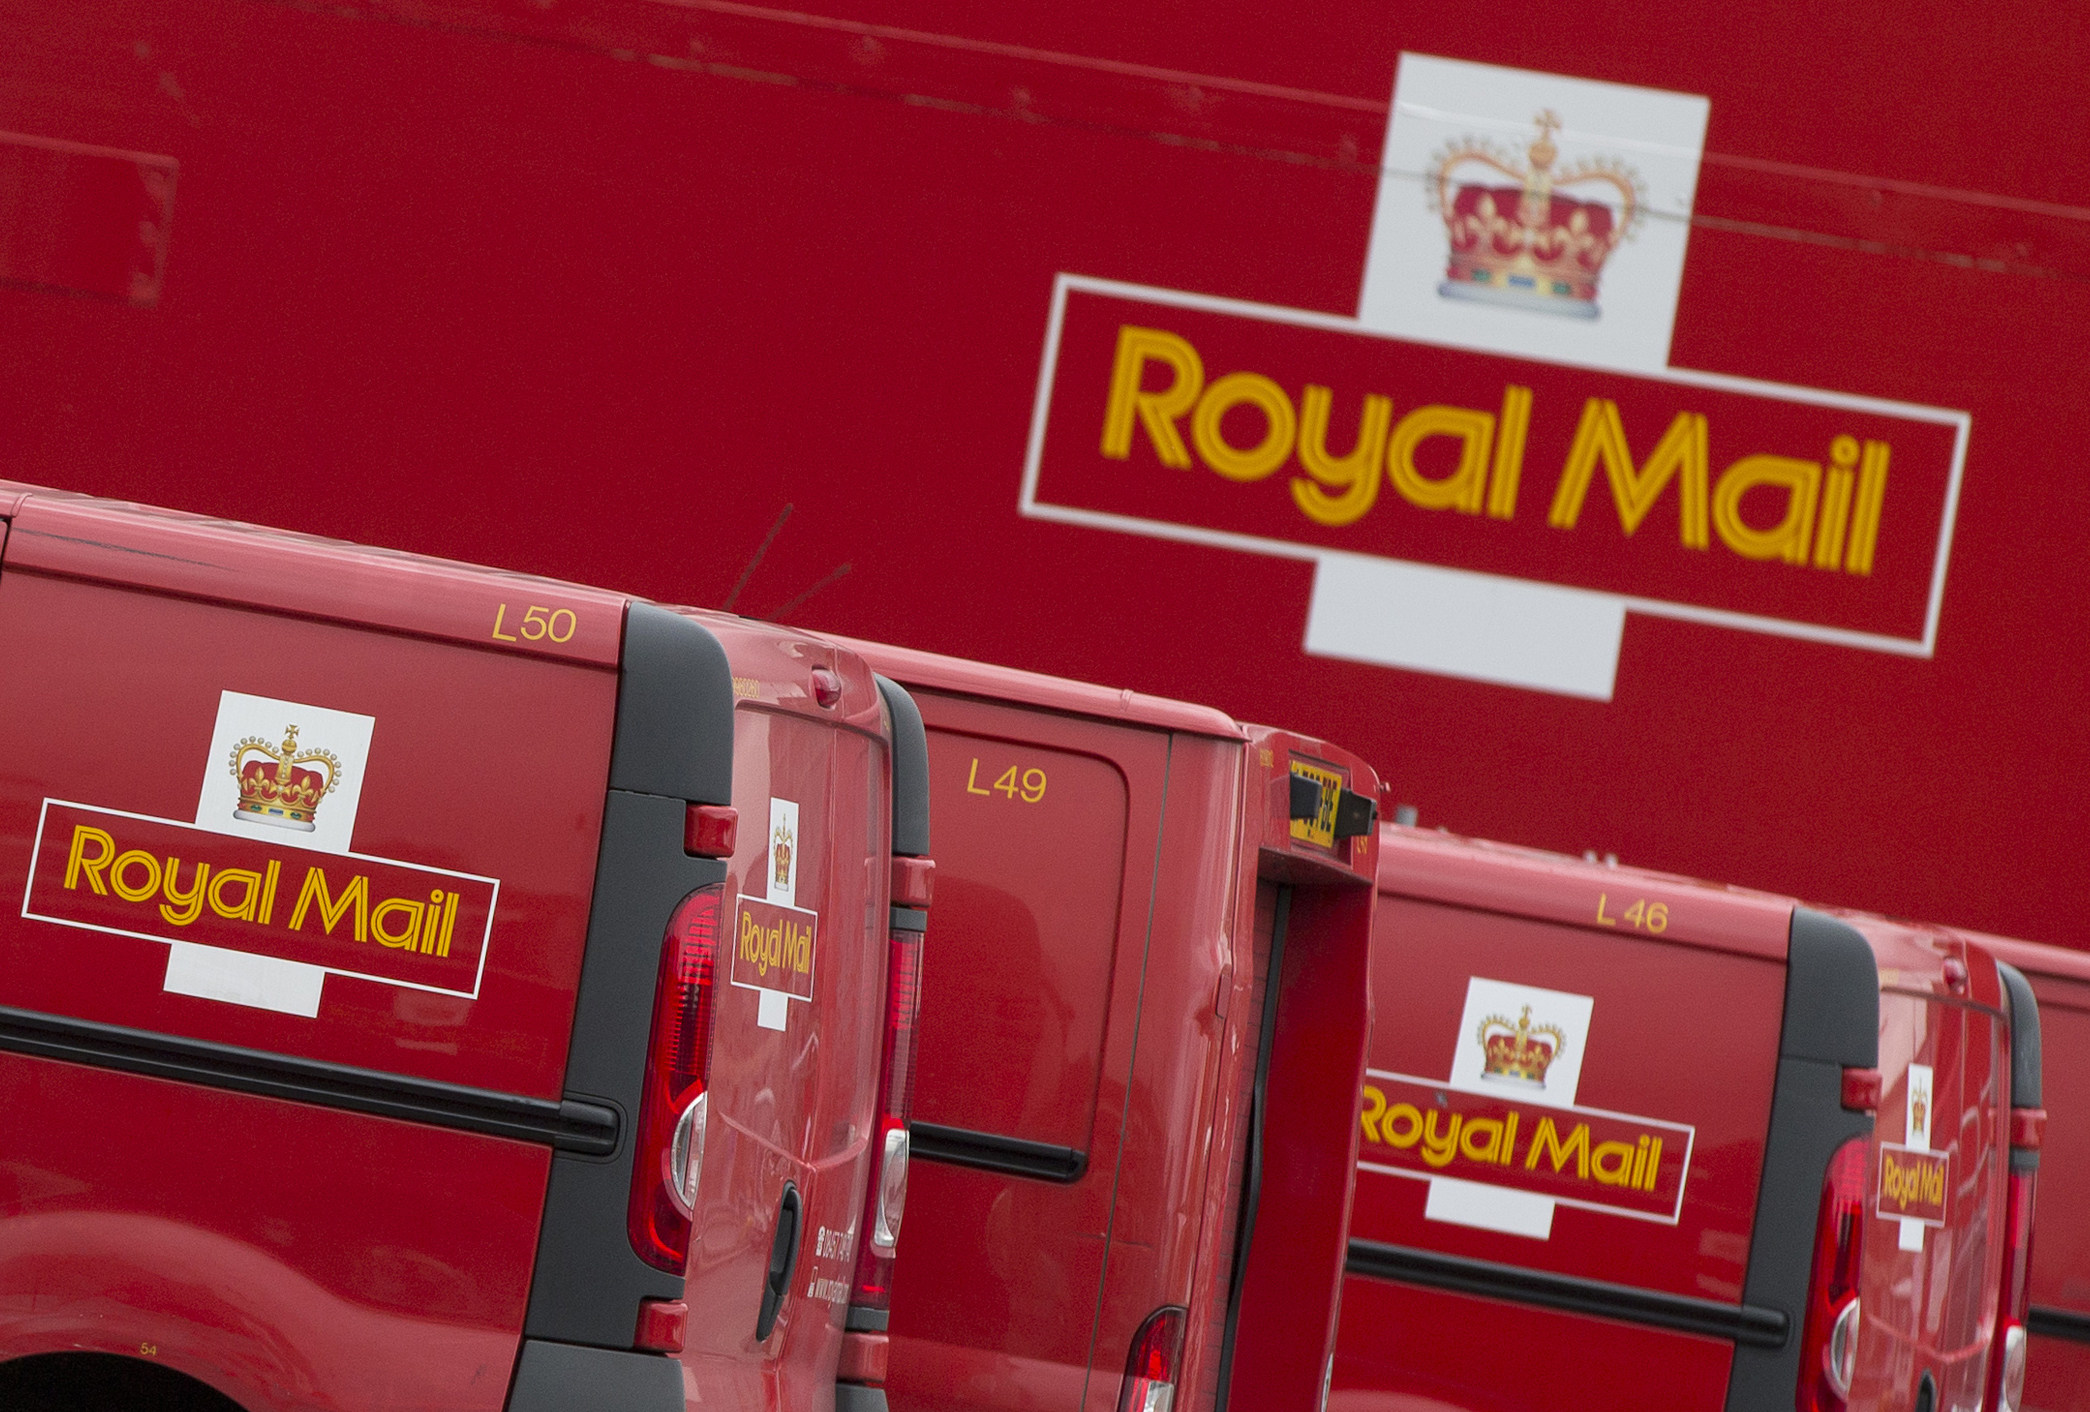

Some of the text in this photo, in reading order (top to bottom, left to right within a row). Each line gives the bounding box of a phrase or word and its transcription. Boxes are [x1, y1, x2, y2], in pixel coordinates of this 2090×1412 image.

[1100, 325, 1892, 576] Royal Mail
[492, 603, 577, 644] L50
[967, 757, 1048, 804] L49
[63, 824, 461, 958] Royal Mail
[740, 911, 812, 977] Royal Mail
[1360, 1084, 1663, 1192] Royal Mail
[1884, 1154, 1921, 1211] Royal
[140, 1342, 158, 1357] 54
